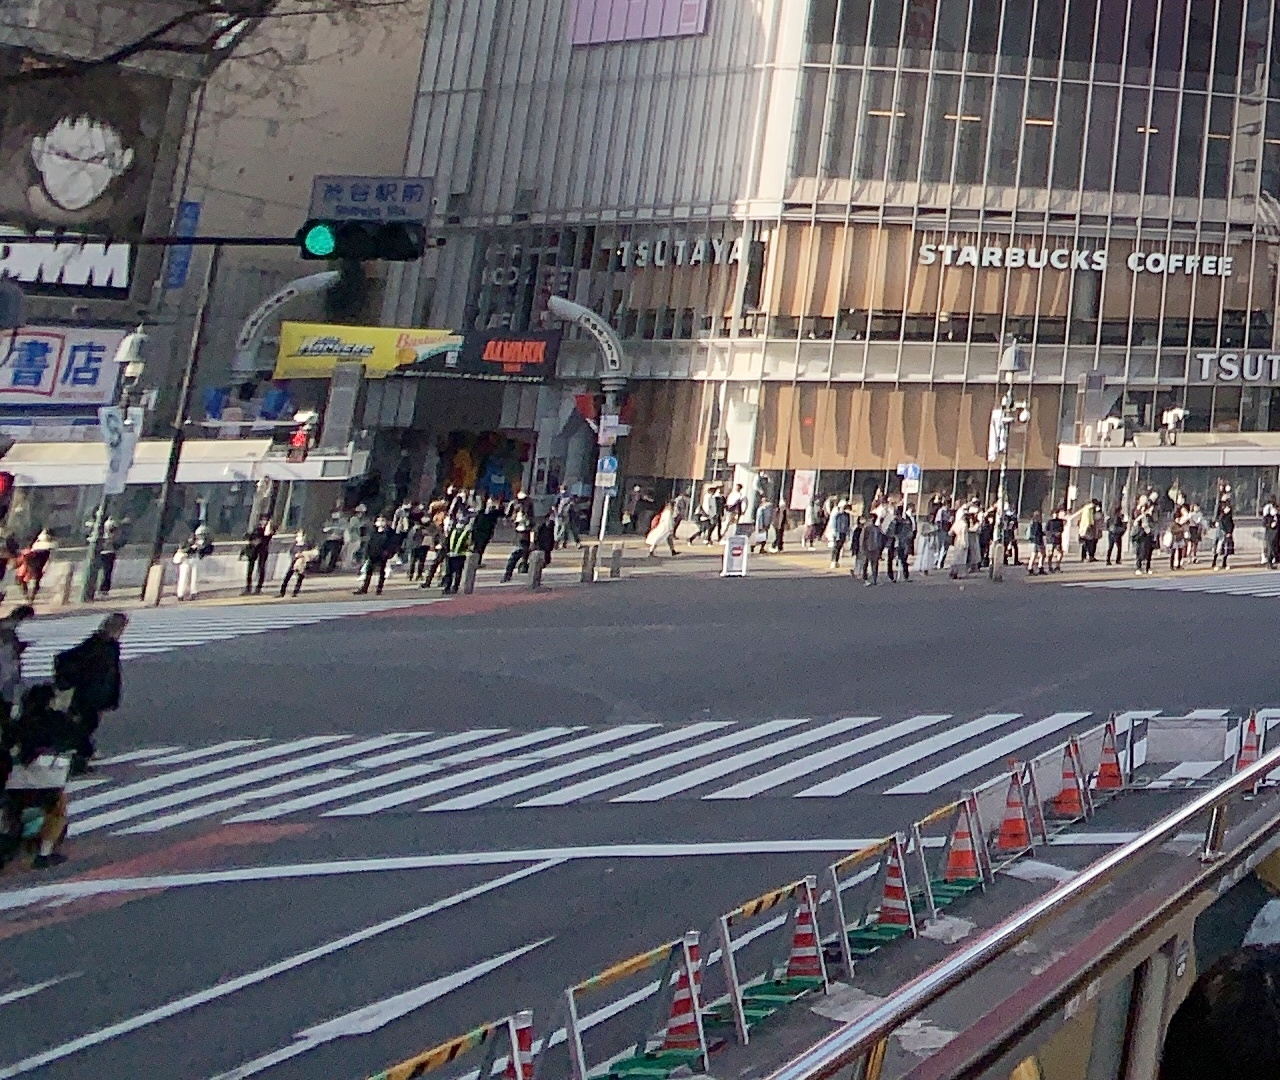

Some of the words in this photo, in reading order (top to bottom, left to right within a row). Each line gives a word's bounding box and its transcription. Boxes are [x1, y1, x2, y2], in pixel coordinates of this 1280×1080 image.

[323, 182, 425, 204] 渋谷駅前
[620, 238, 742, 267] TSUTAYA
[919, 245, 1107, 272] STARBUCKS
[1127, 252, 1233, 277] COFFEE
[10, 340, 107, 386] 書店
